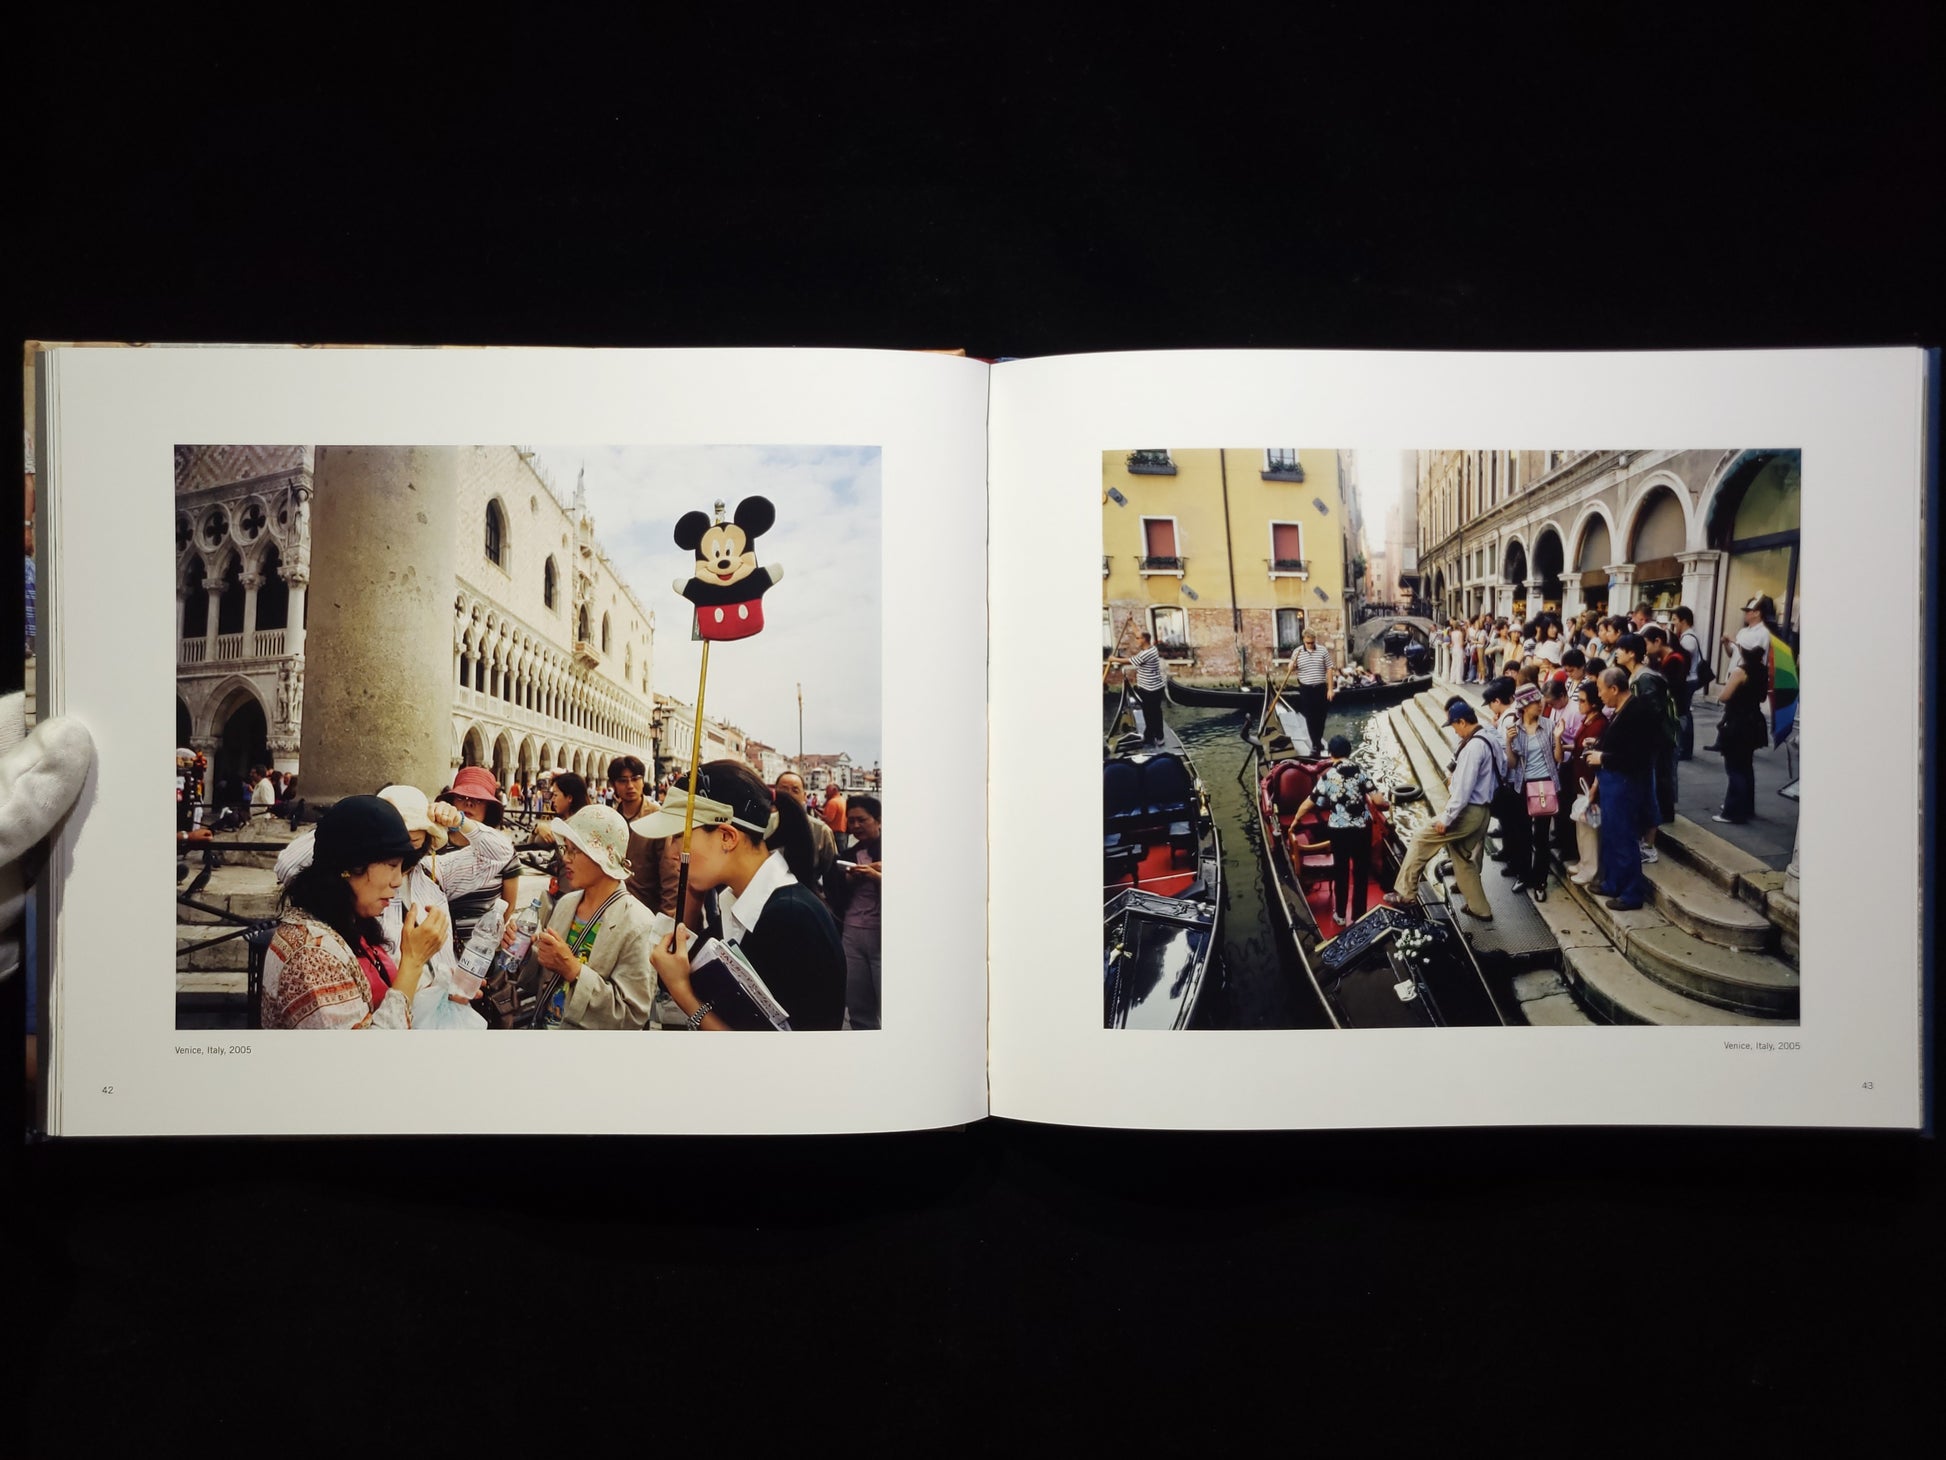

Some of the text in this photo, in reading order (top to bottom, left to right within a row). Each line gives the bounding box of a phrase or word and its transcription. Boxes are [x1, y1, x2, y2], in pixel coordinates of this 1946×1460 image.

[174, 1045, 252, 1056] Venice, Italy, 2005
[1723, 1041, 1801, 1052] Venice, Italy, 2005
[101, 1085, 114, 1094] 42
[1861, 1081, 1874, 1090] 43
